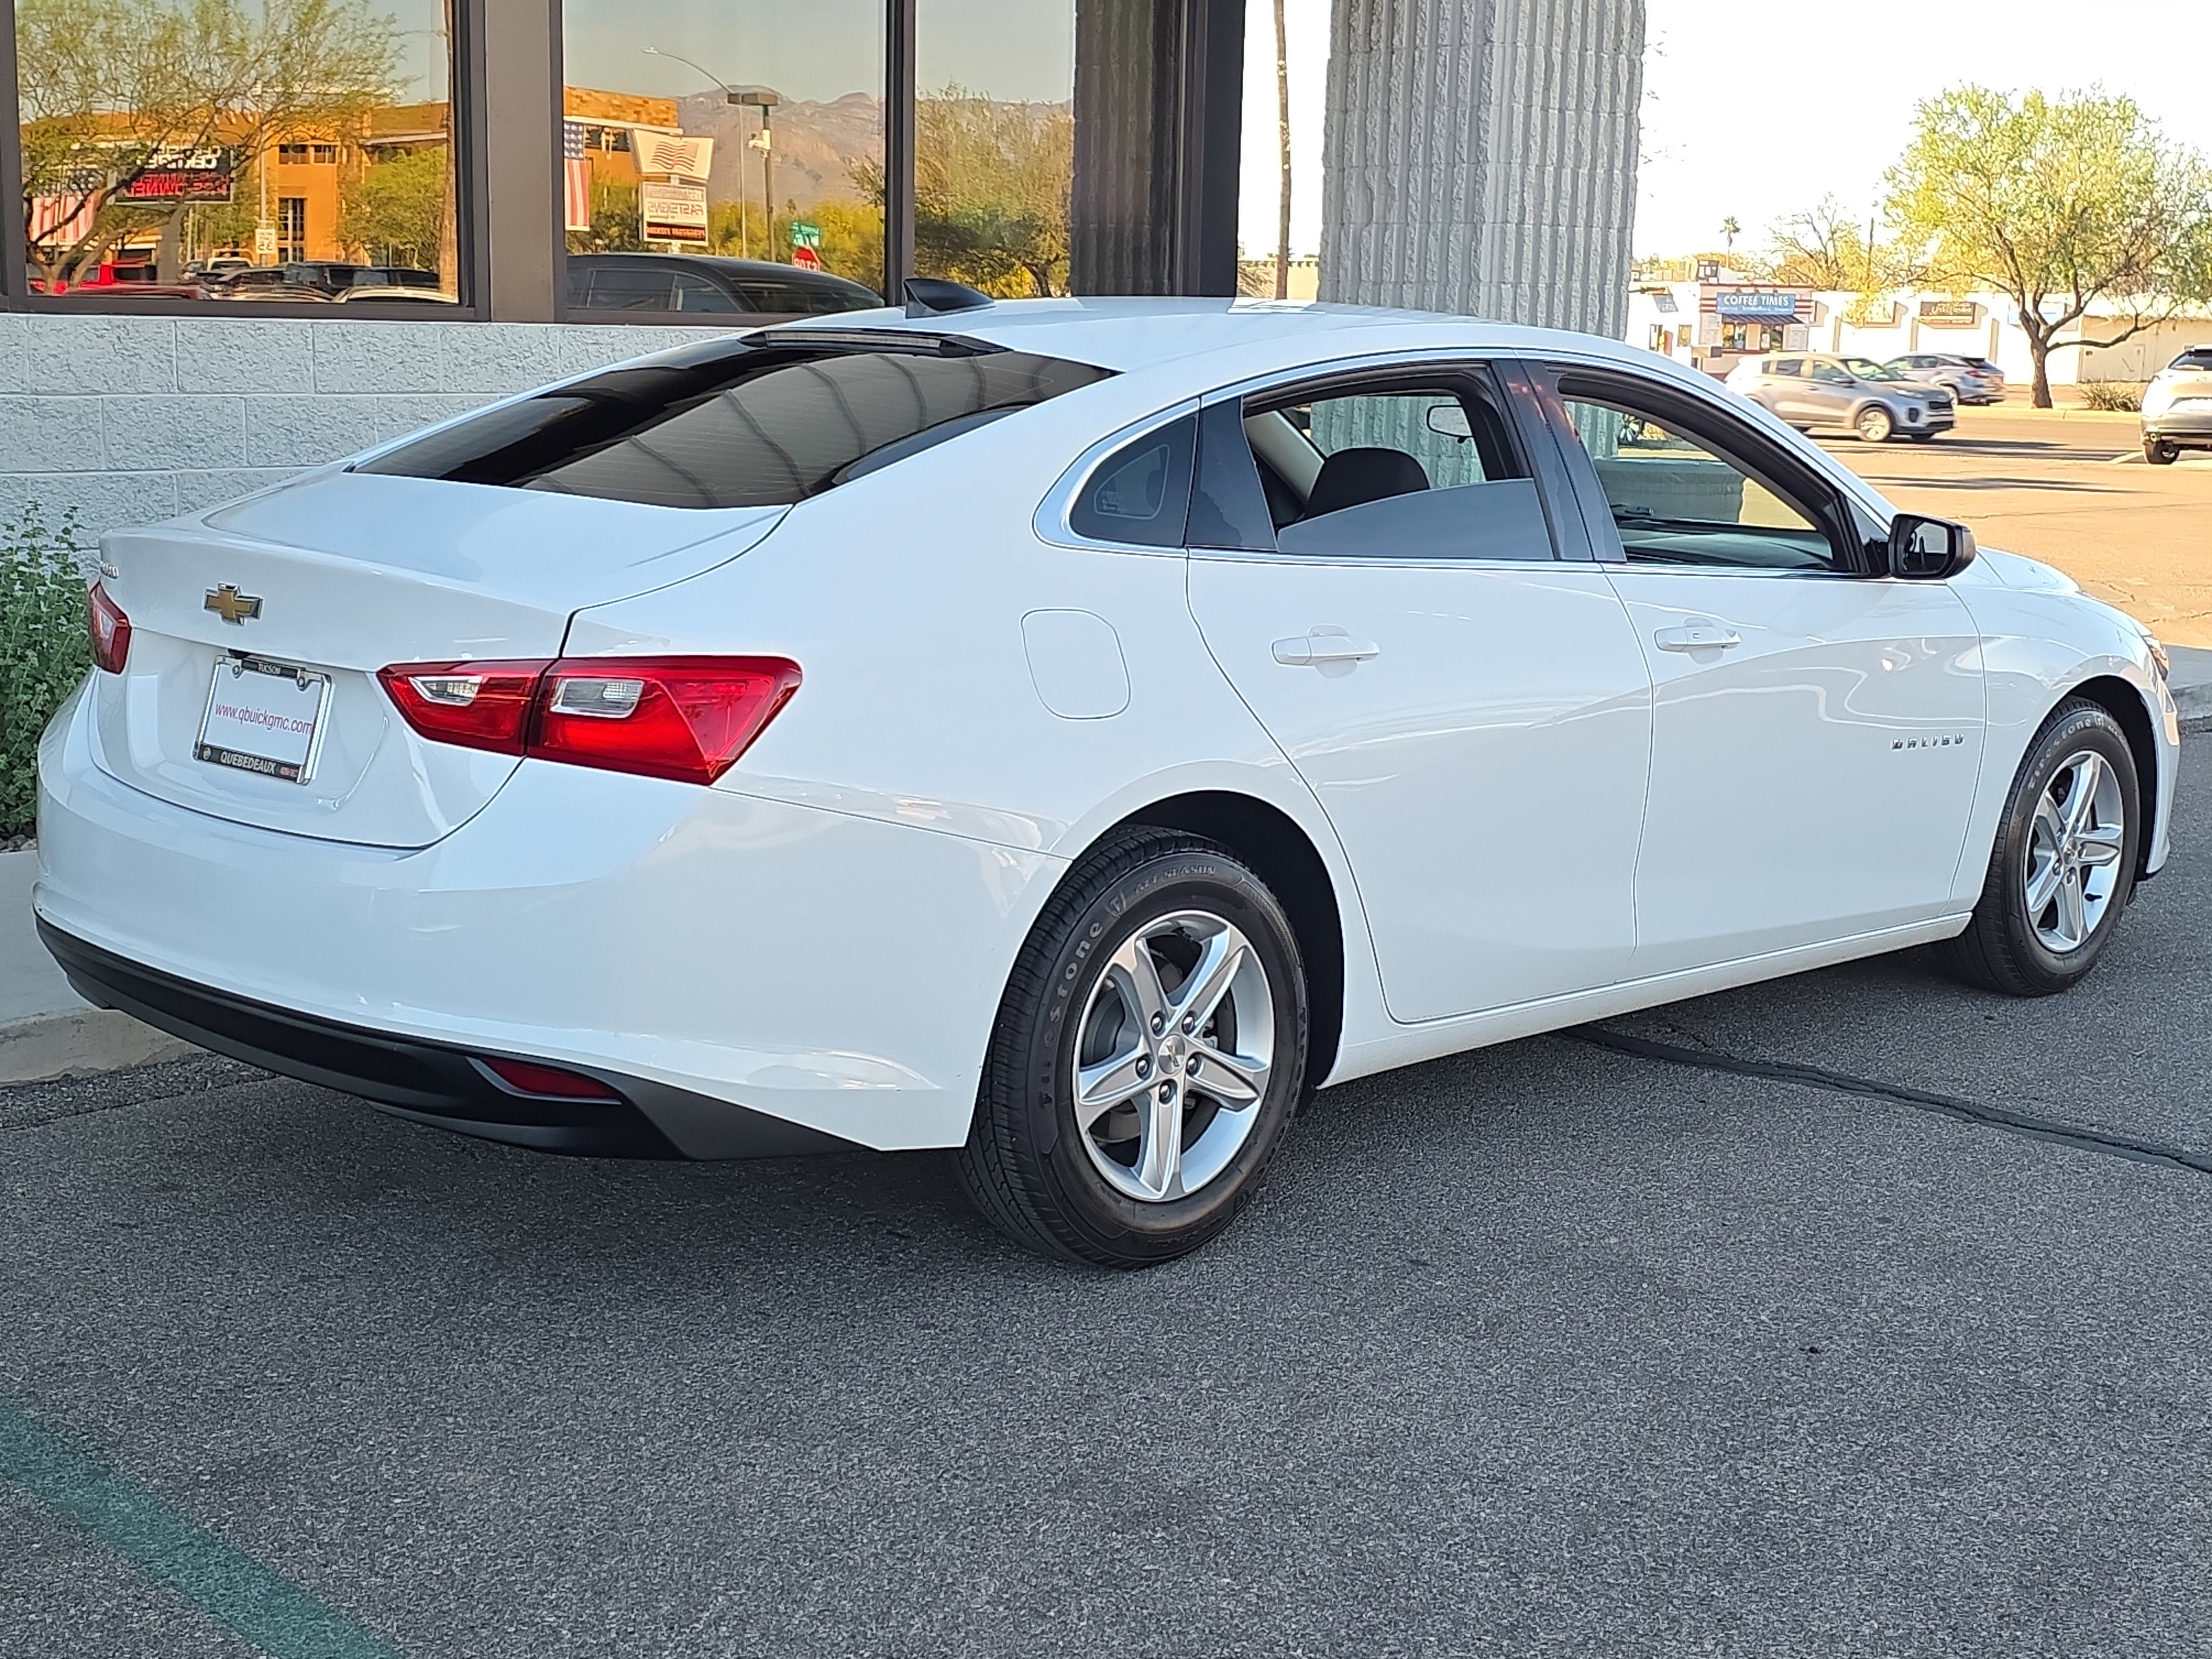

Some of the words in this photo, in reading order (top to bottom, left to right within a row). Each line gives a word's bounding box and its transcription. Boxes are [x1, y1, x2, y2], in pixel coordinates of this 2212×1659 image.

[1724, 294, 1758, 305] COFFEE
[1761, 295, 1789, 306] TIMES
[215, 703, 313, 734] www.qbuickgmc.com
[1892, 733, 1964, 751] MALIBU
[220, 751, 276, 775] QUEBEDEAUX
